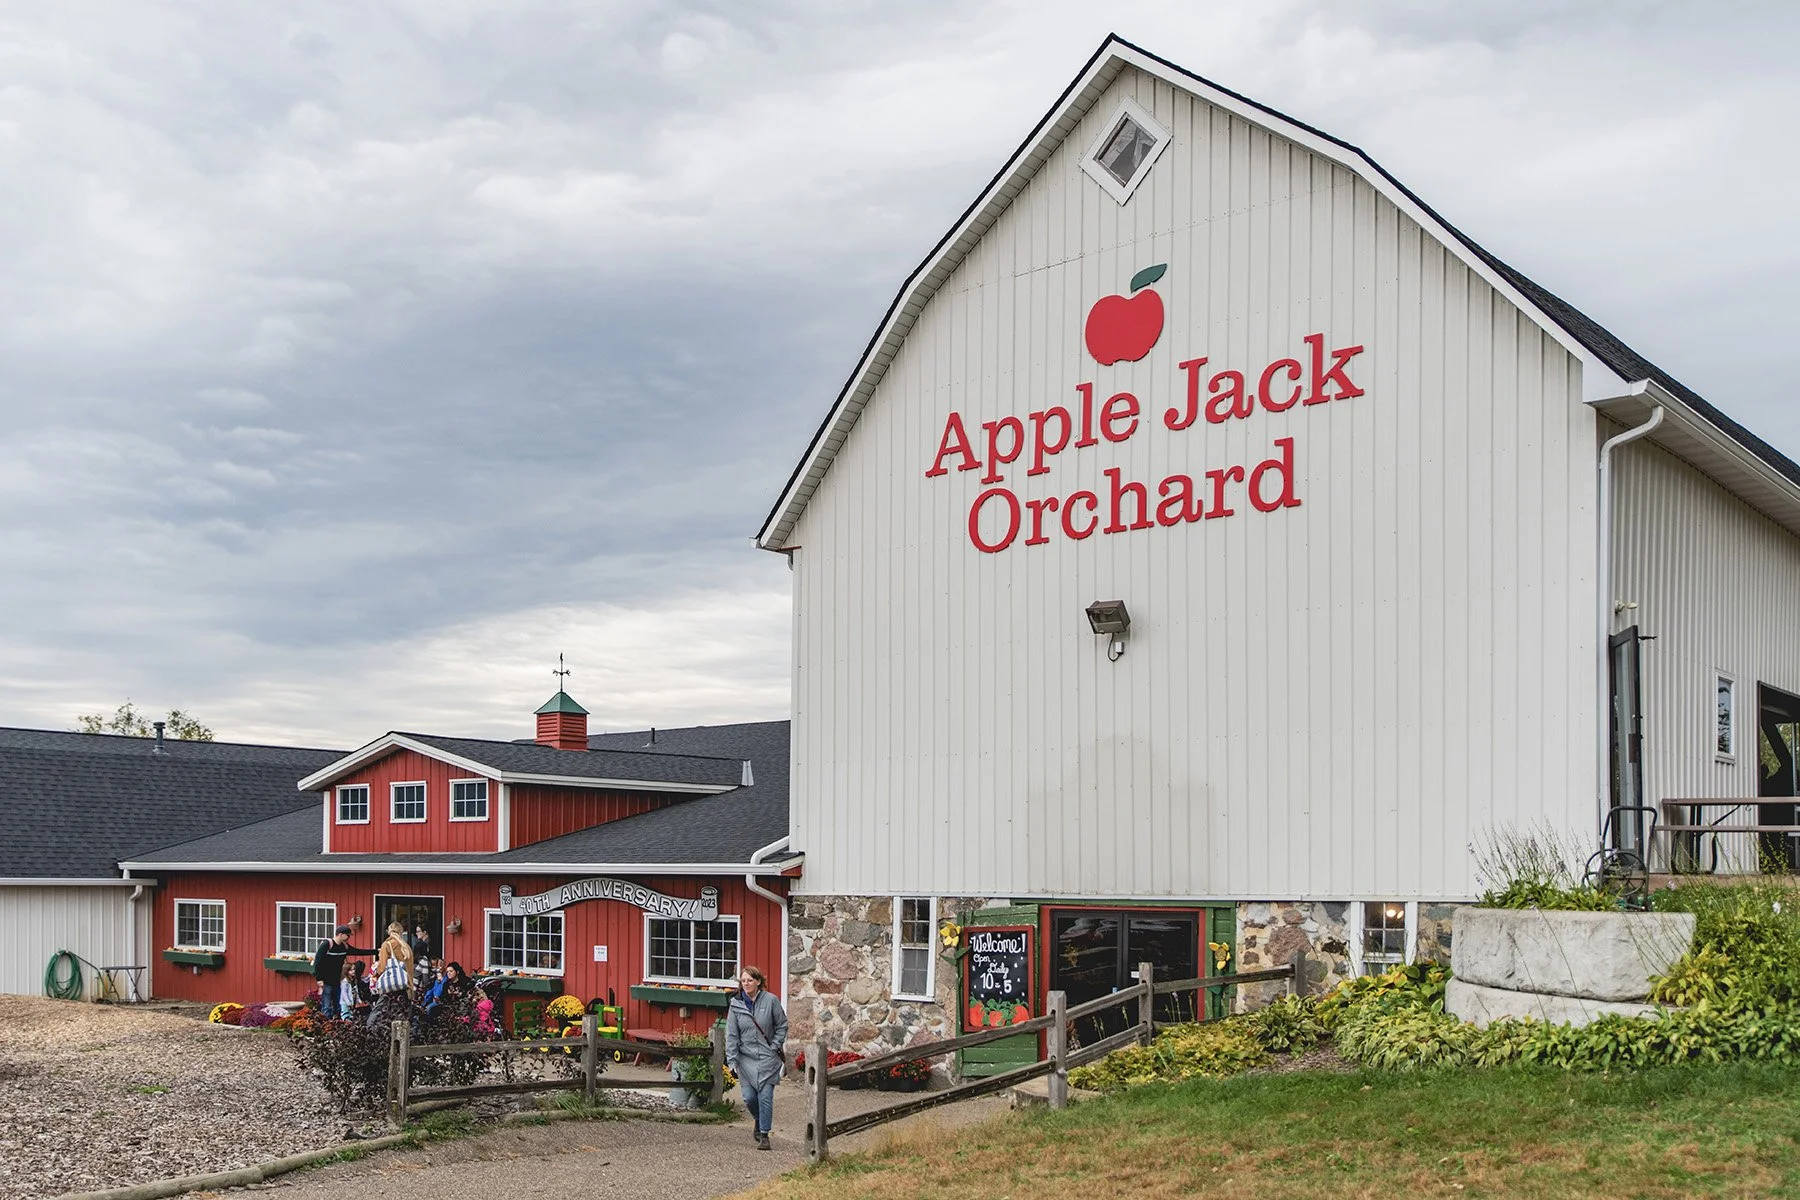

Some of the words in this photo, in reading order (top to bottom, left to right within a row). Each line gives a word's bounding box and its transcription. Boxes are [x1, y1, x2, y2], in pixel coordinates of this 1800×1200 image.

[925, 382, 1140, 485] Apple
[1163, 332, 1365, 431] Jack
[967, 436, 1302, 553] Orchard
[519, 893, 551, 914] 40TH
[560, 879, 699, 919] ANNIVERSARY!
[971, 933, 1026, 953] Welcome!
